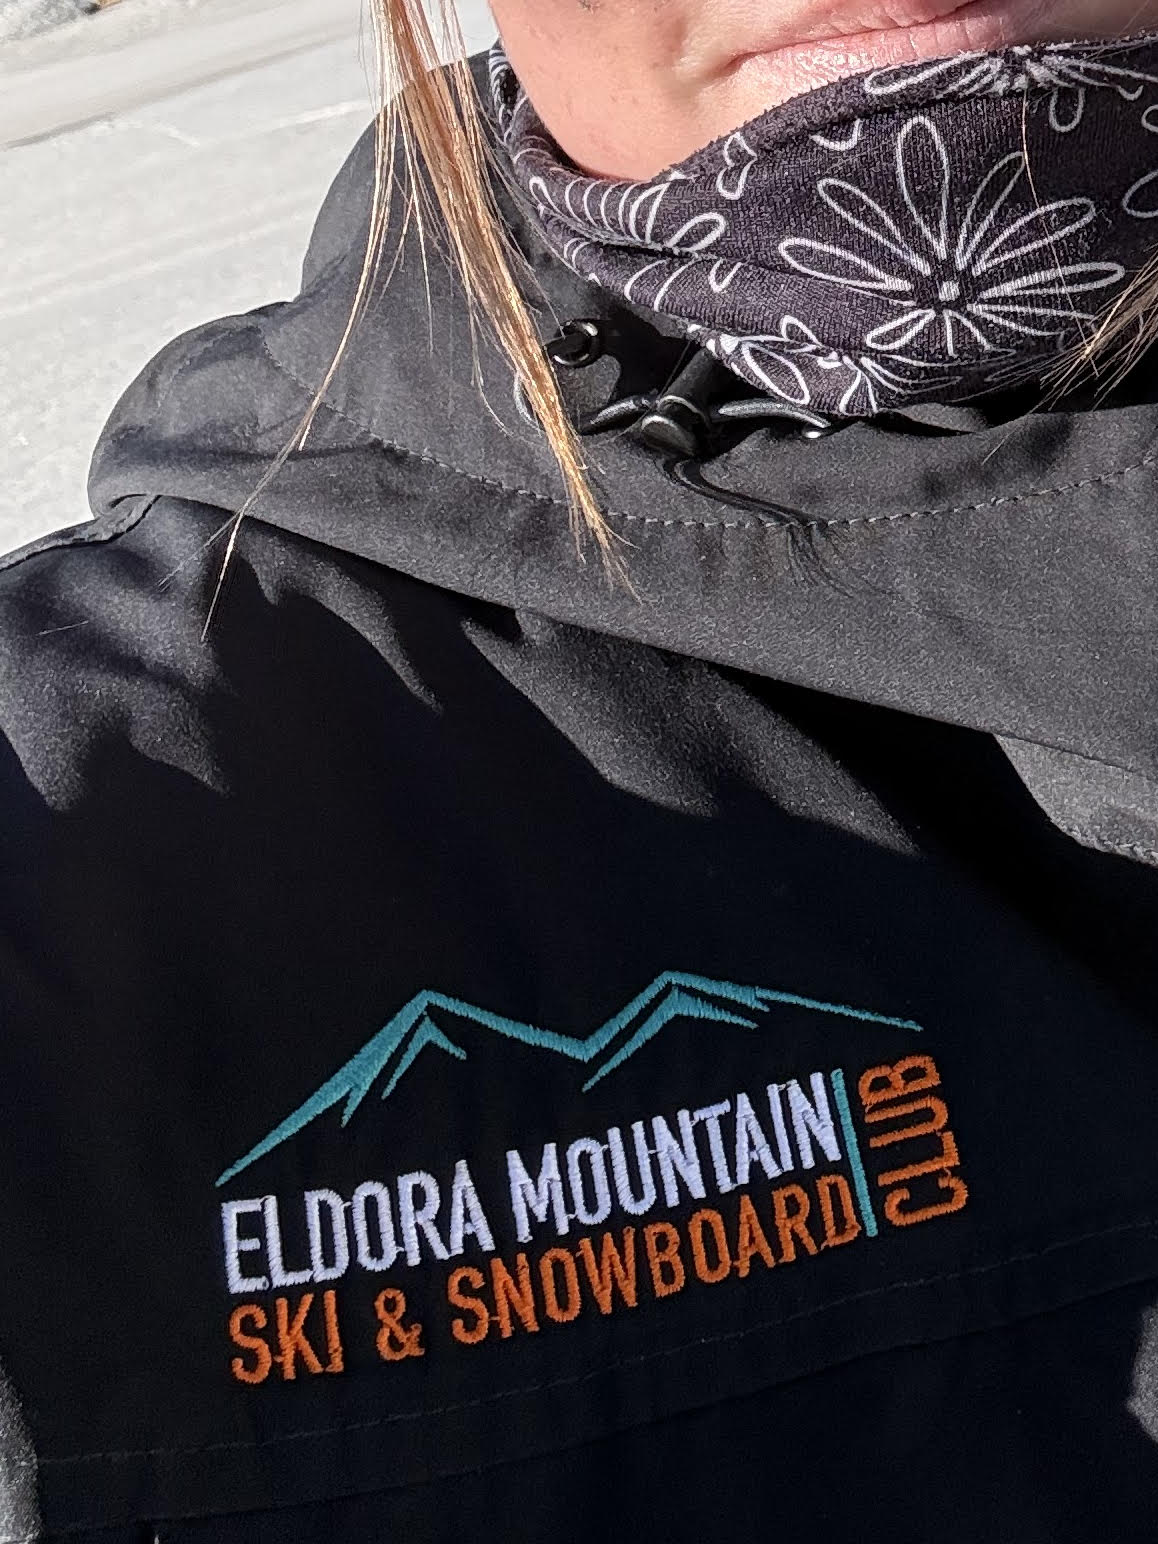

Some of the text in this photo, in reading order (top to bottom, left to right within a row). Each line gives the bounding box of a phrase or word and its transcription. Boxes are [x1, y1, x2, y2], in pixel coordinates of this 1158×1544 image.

[220, 1071, 842, 1294] ELDORA MOUNTAIN
[858, 1055, 969, 1227] CLUB
[229, 1174, 861, 1384] SKI & SNOWBOARD
